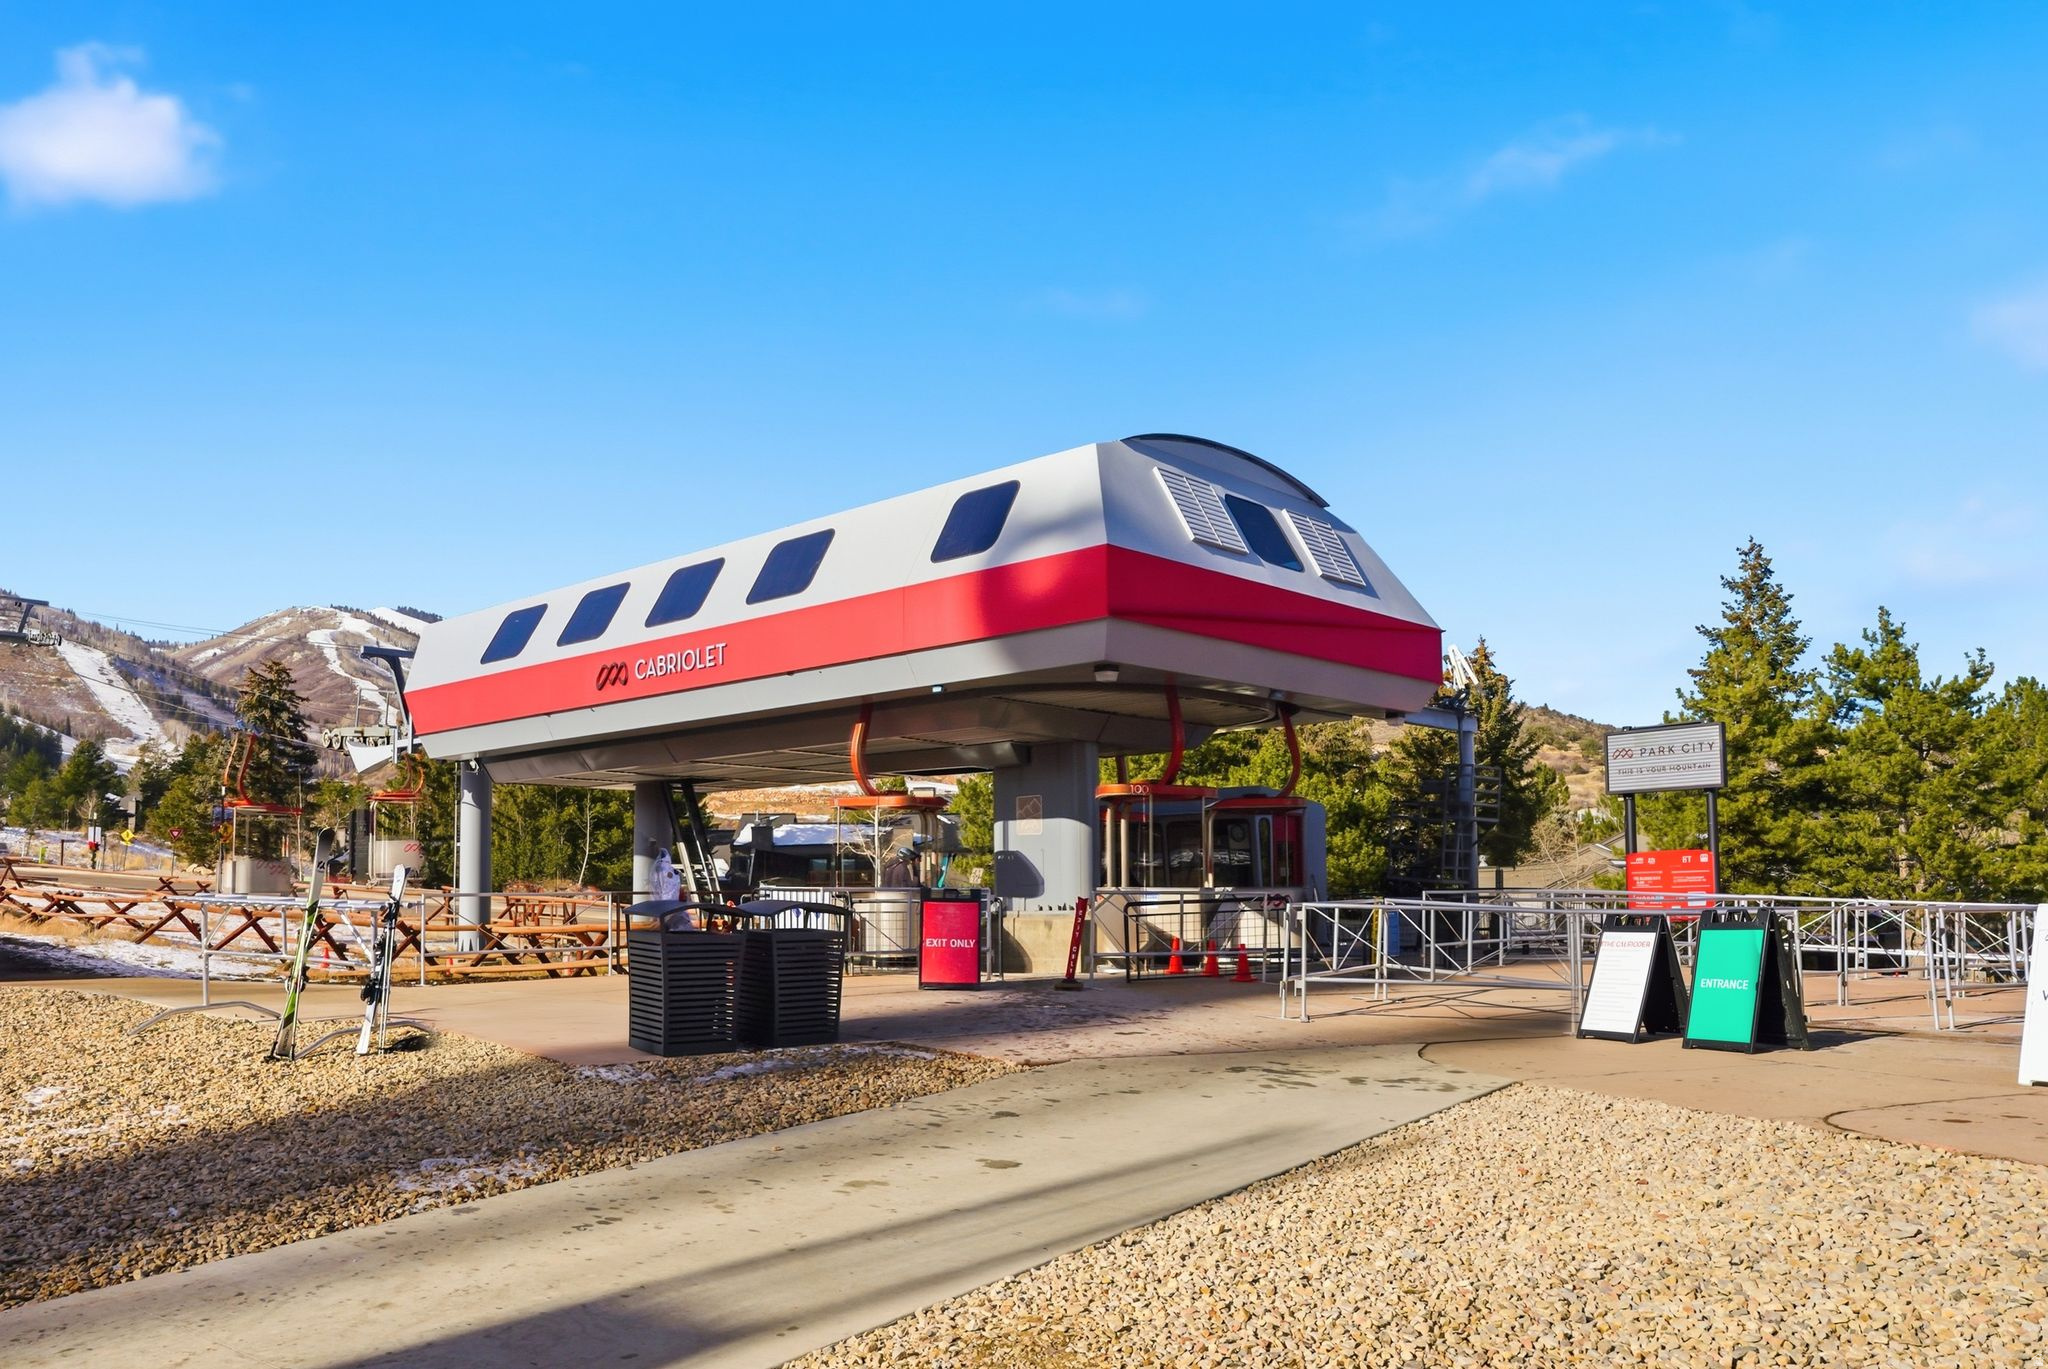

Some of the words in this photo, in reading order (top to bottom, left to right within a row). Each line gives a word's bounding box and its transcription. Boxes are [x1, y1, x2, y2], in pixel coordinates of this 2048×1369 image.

[635, 643, 727, 679] CABRIOLET
[1640, 745, 1675, 757] PARK
[1681, 742, 1715, 754] CITY
[925, 938, 947, 948] EXIT
[950, 938, 976, 948] ONLY
[1700, 978, 1749, 990] ENTRANCE
